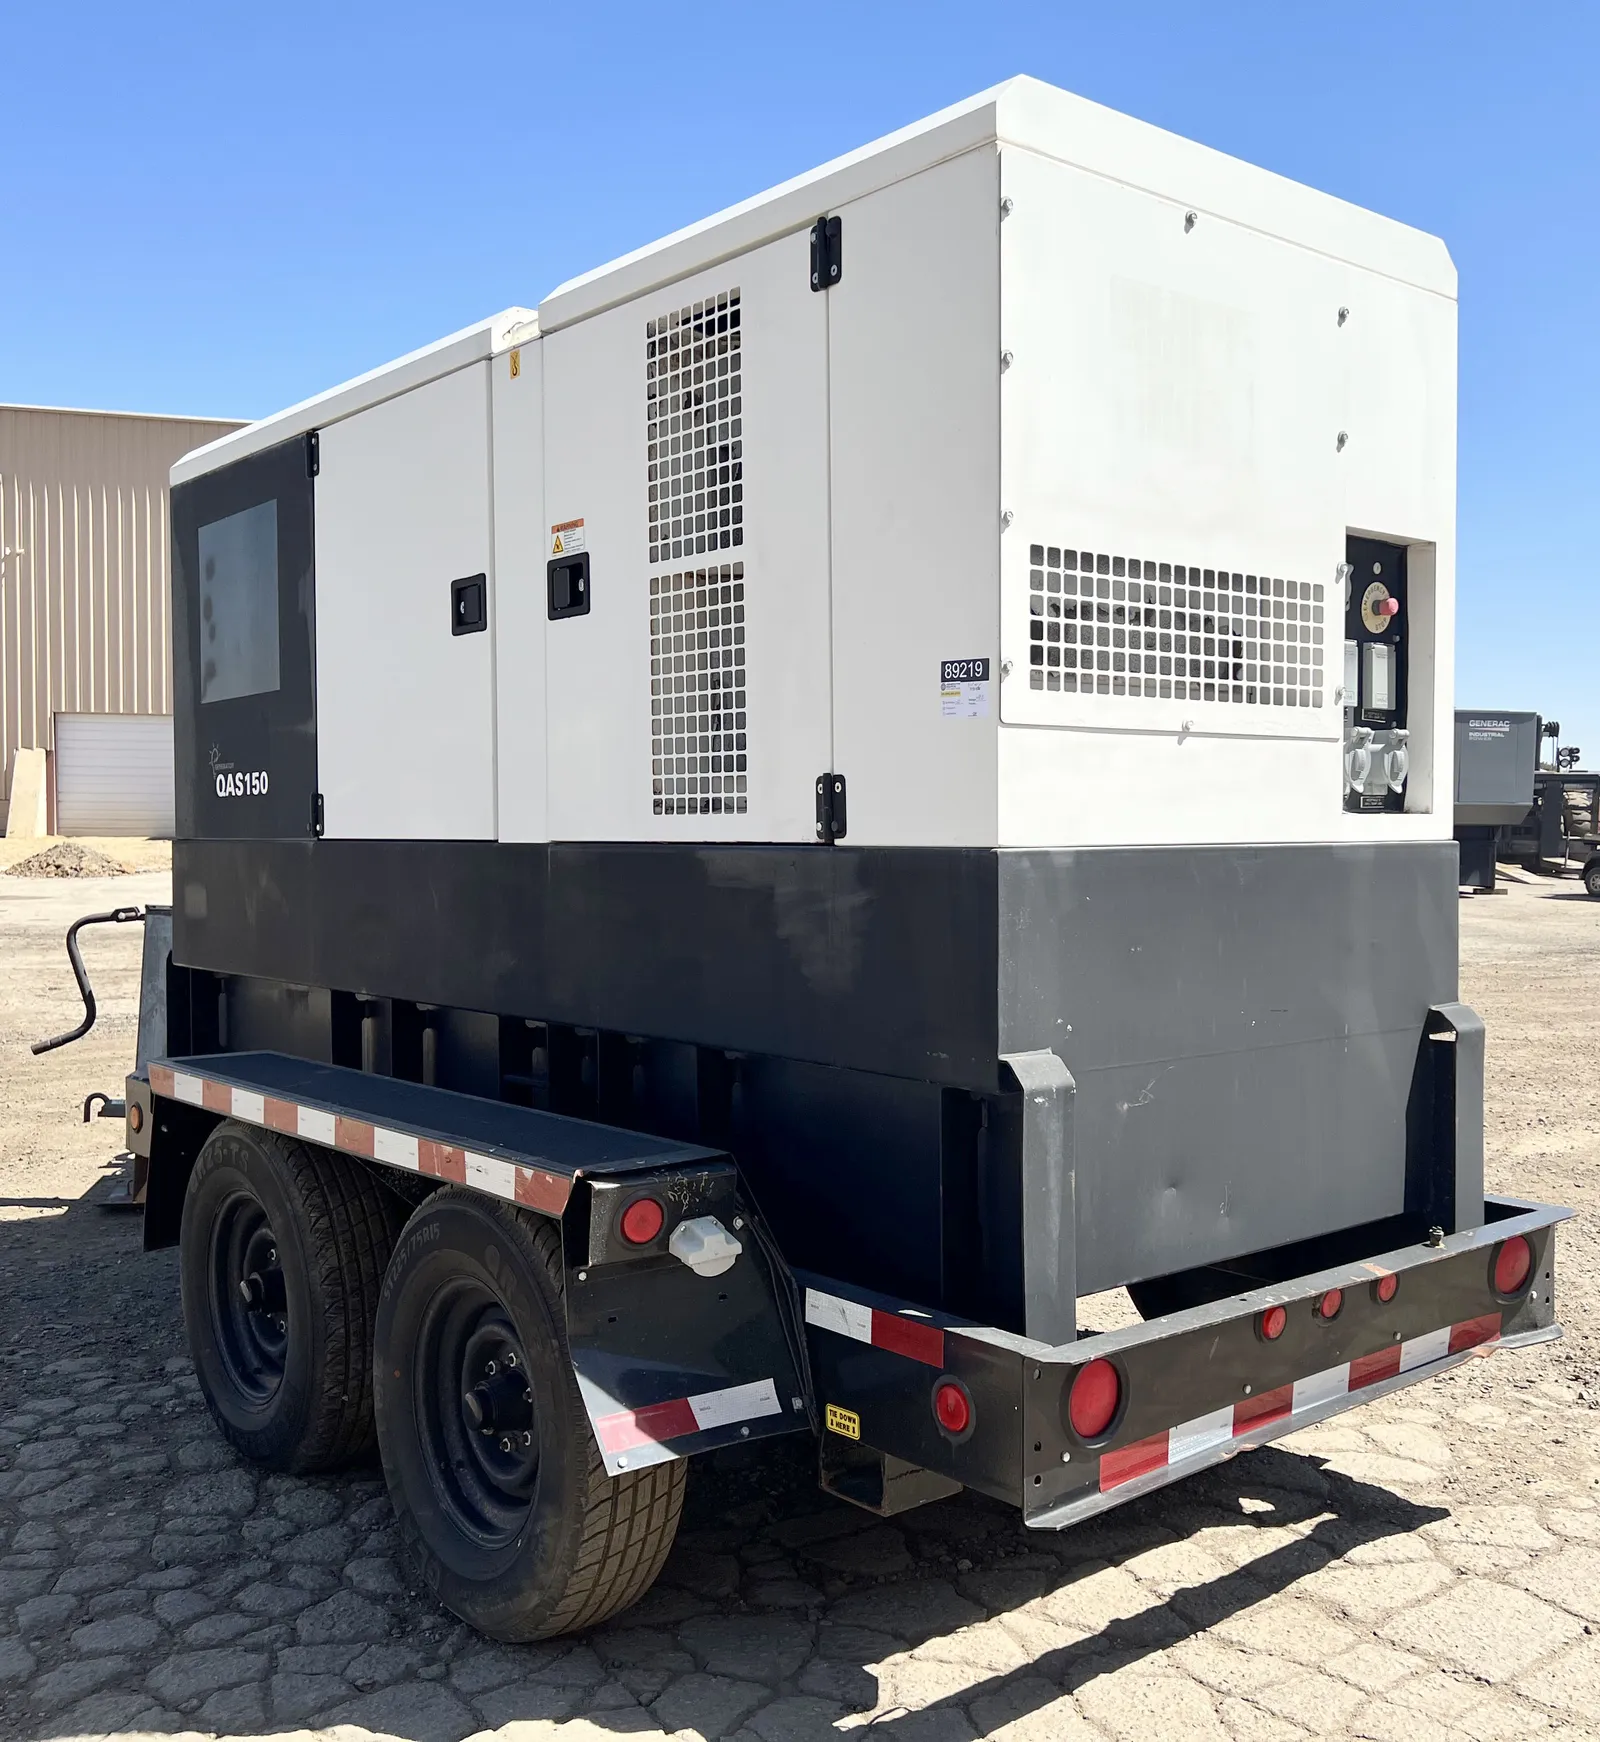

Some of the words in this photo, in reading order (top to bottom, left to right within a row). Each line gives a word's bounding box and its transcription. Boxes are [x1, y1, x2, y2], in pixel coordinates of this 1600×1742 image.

[944, 661, 983, 679] 89219
[1469, 719, 1510, 727] GENERAC
[216, 770, 269, 798] QAS150
[829, 1409, 838, 1418] TIE
[839, 1412, 857, 1425] DOWN
[835, 1421, 851, 1432] HERE
